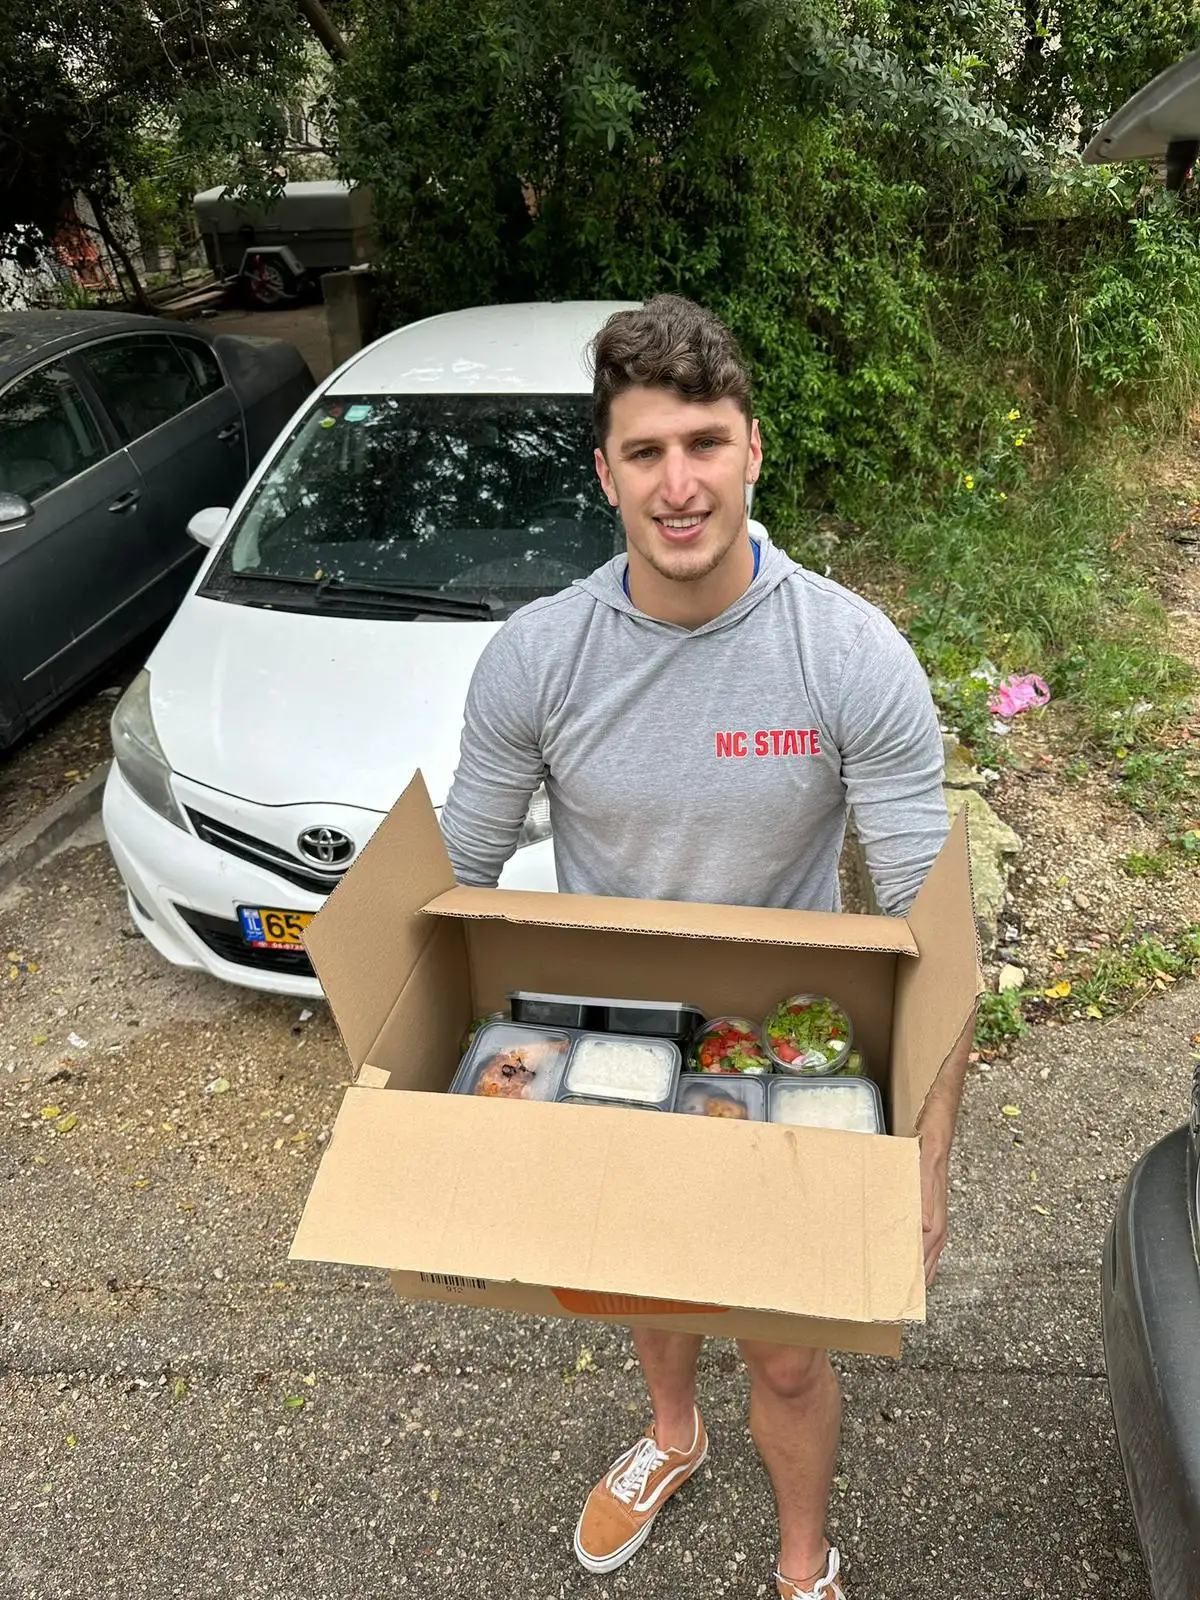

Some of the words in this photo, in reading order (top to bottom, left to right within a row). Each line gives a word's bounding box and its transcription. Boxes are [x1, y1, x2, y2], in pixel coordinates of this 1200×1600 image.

[715, 731, 748, 759] NC
[754, 729, 821, 757] STATE
[265, 913, 304, 940] 65
